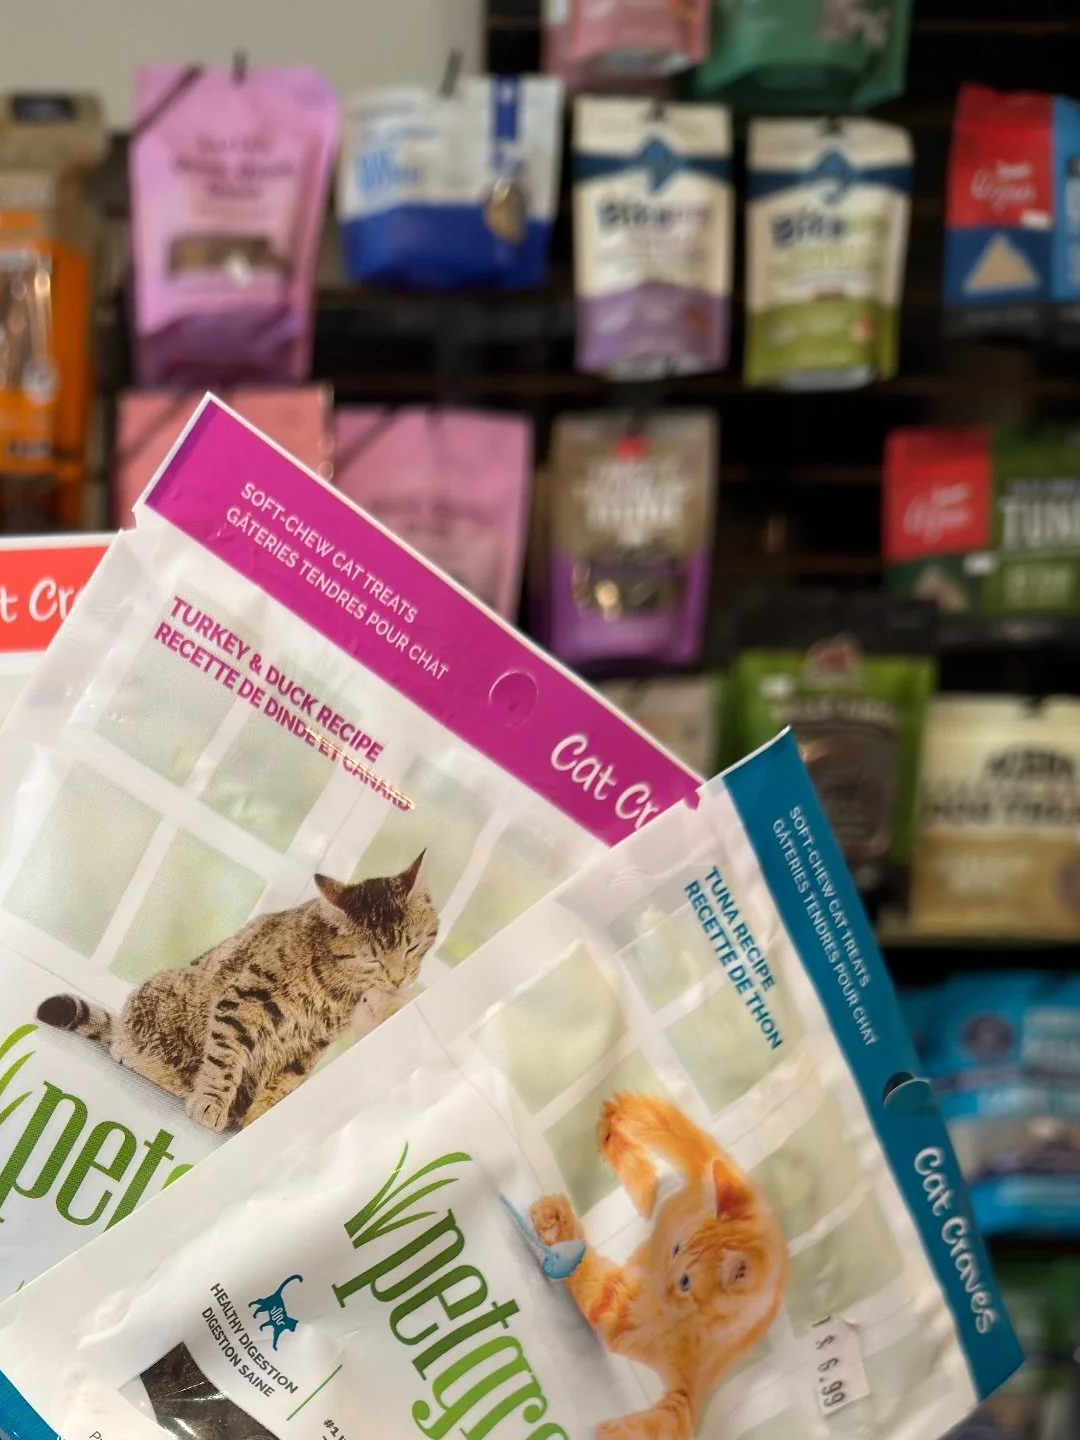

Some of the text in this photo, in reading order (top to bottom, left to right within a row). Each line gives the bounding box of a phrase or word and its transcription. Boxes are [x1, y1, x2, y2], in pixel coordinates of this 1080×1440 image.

[28, 576, 85, 623] Cr
[226, 507, 449, 680] GÂTERIES TENDRES POUR CHAT
[240, 482, 418, 623] SOFT-CHEW CAT TREATS
[153, 621, 414, 812] RECETTE DE DINDE ET CANARD
[169, 596, 384, 764] TURKEY & DUCK RECIPE
[550, 734, 617, 801] Cat
[684, 880, 784, 1050] RECETTE DE THON
[704, 865, 776, 992] TUNA RECIPE
[773, 818, 879, 1046] GÂTERIES TENDRES POUR CHAT
[789, 804, 871, 988] SOFT-CHEW CAT TREATS
[914, 1146, 997, 1334] Cat Craves
[201, 1306, 276, 1398] DIGESTION SAINE
[210, 1282, 299, 1395] HEALTHY DIGESTION
[817, 1357, 846, 1407] 6.99
[323, 1418, 339, 1438] #1
